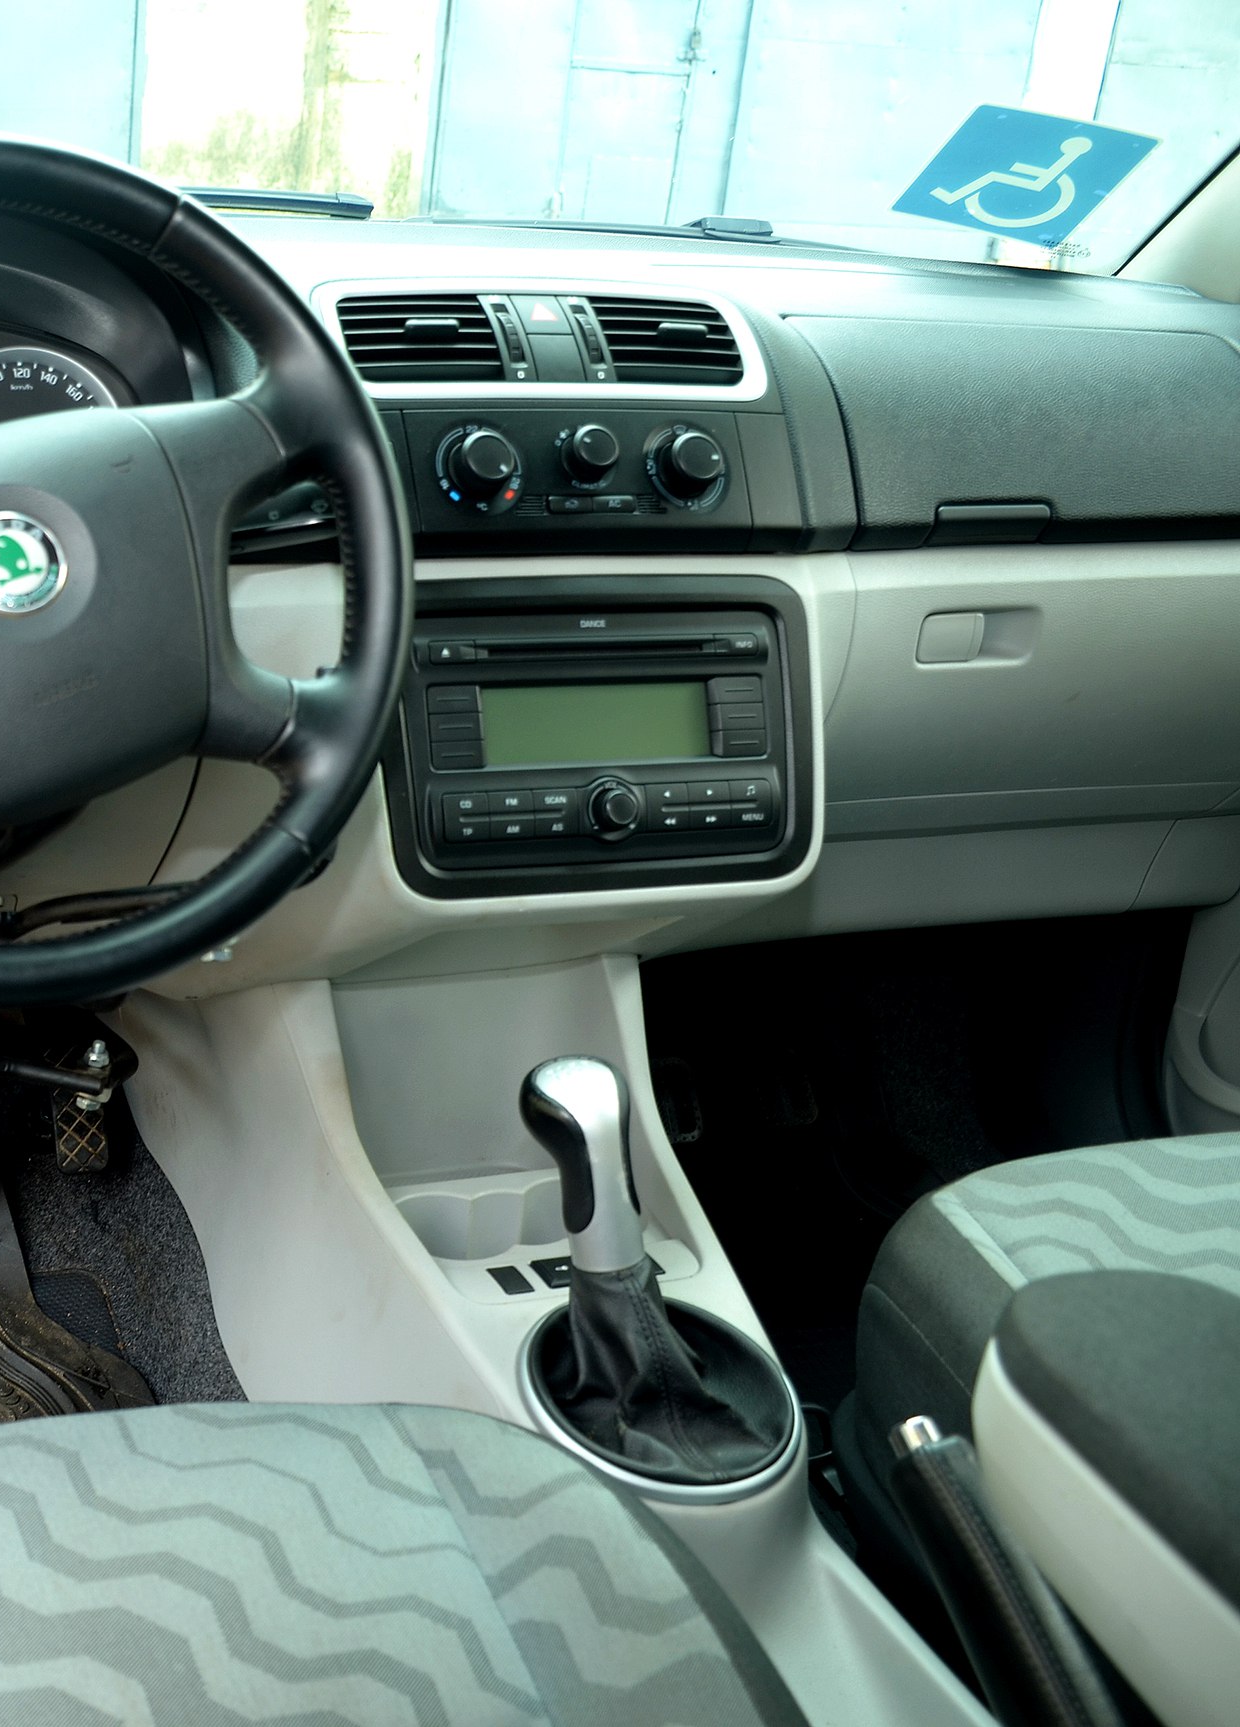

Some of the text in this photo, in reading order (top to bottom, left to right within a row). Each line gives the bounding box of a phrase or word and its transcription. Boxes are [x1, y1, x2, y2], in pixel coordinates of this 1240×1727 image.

[13, 368, 31, 379] 120
[40, 371, 58, 385] 140
[65, 384, 83, 401] 160
[579, 619, 606, 628] DANCE
[735, 641, 753, 649] INFO
[459, 800, 472, 809] CD
[505, 797, 518, 806] FM
[544, 796, 566, 805] SCAN
[742, 812, 765, 821] MENU
[506, 825, 520, 834] AM
